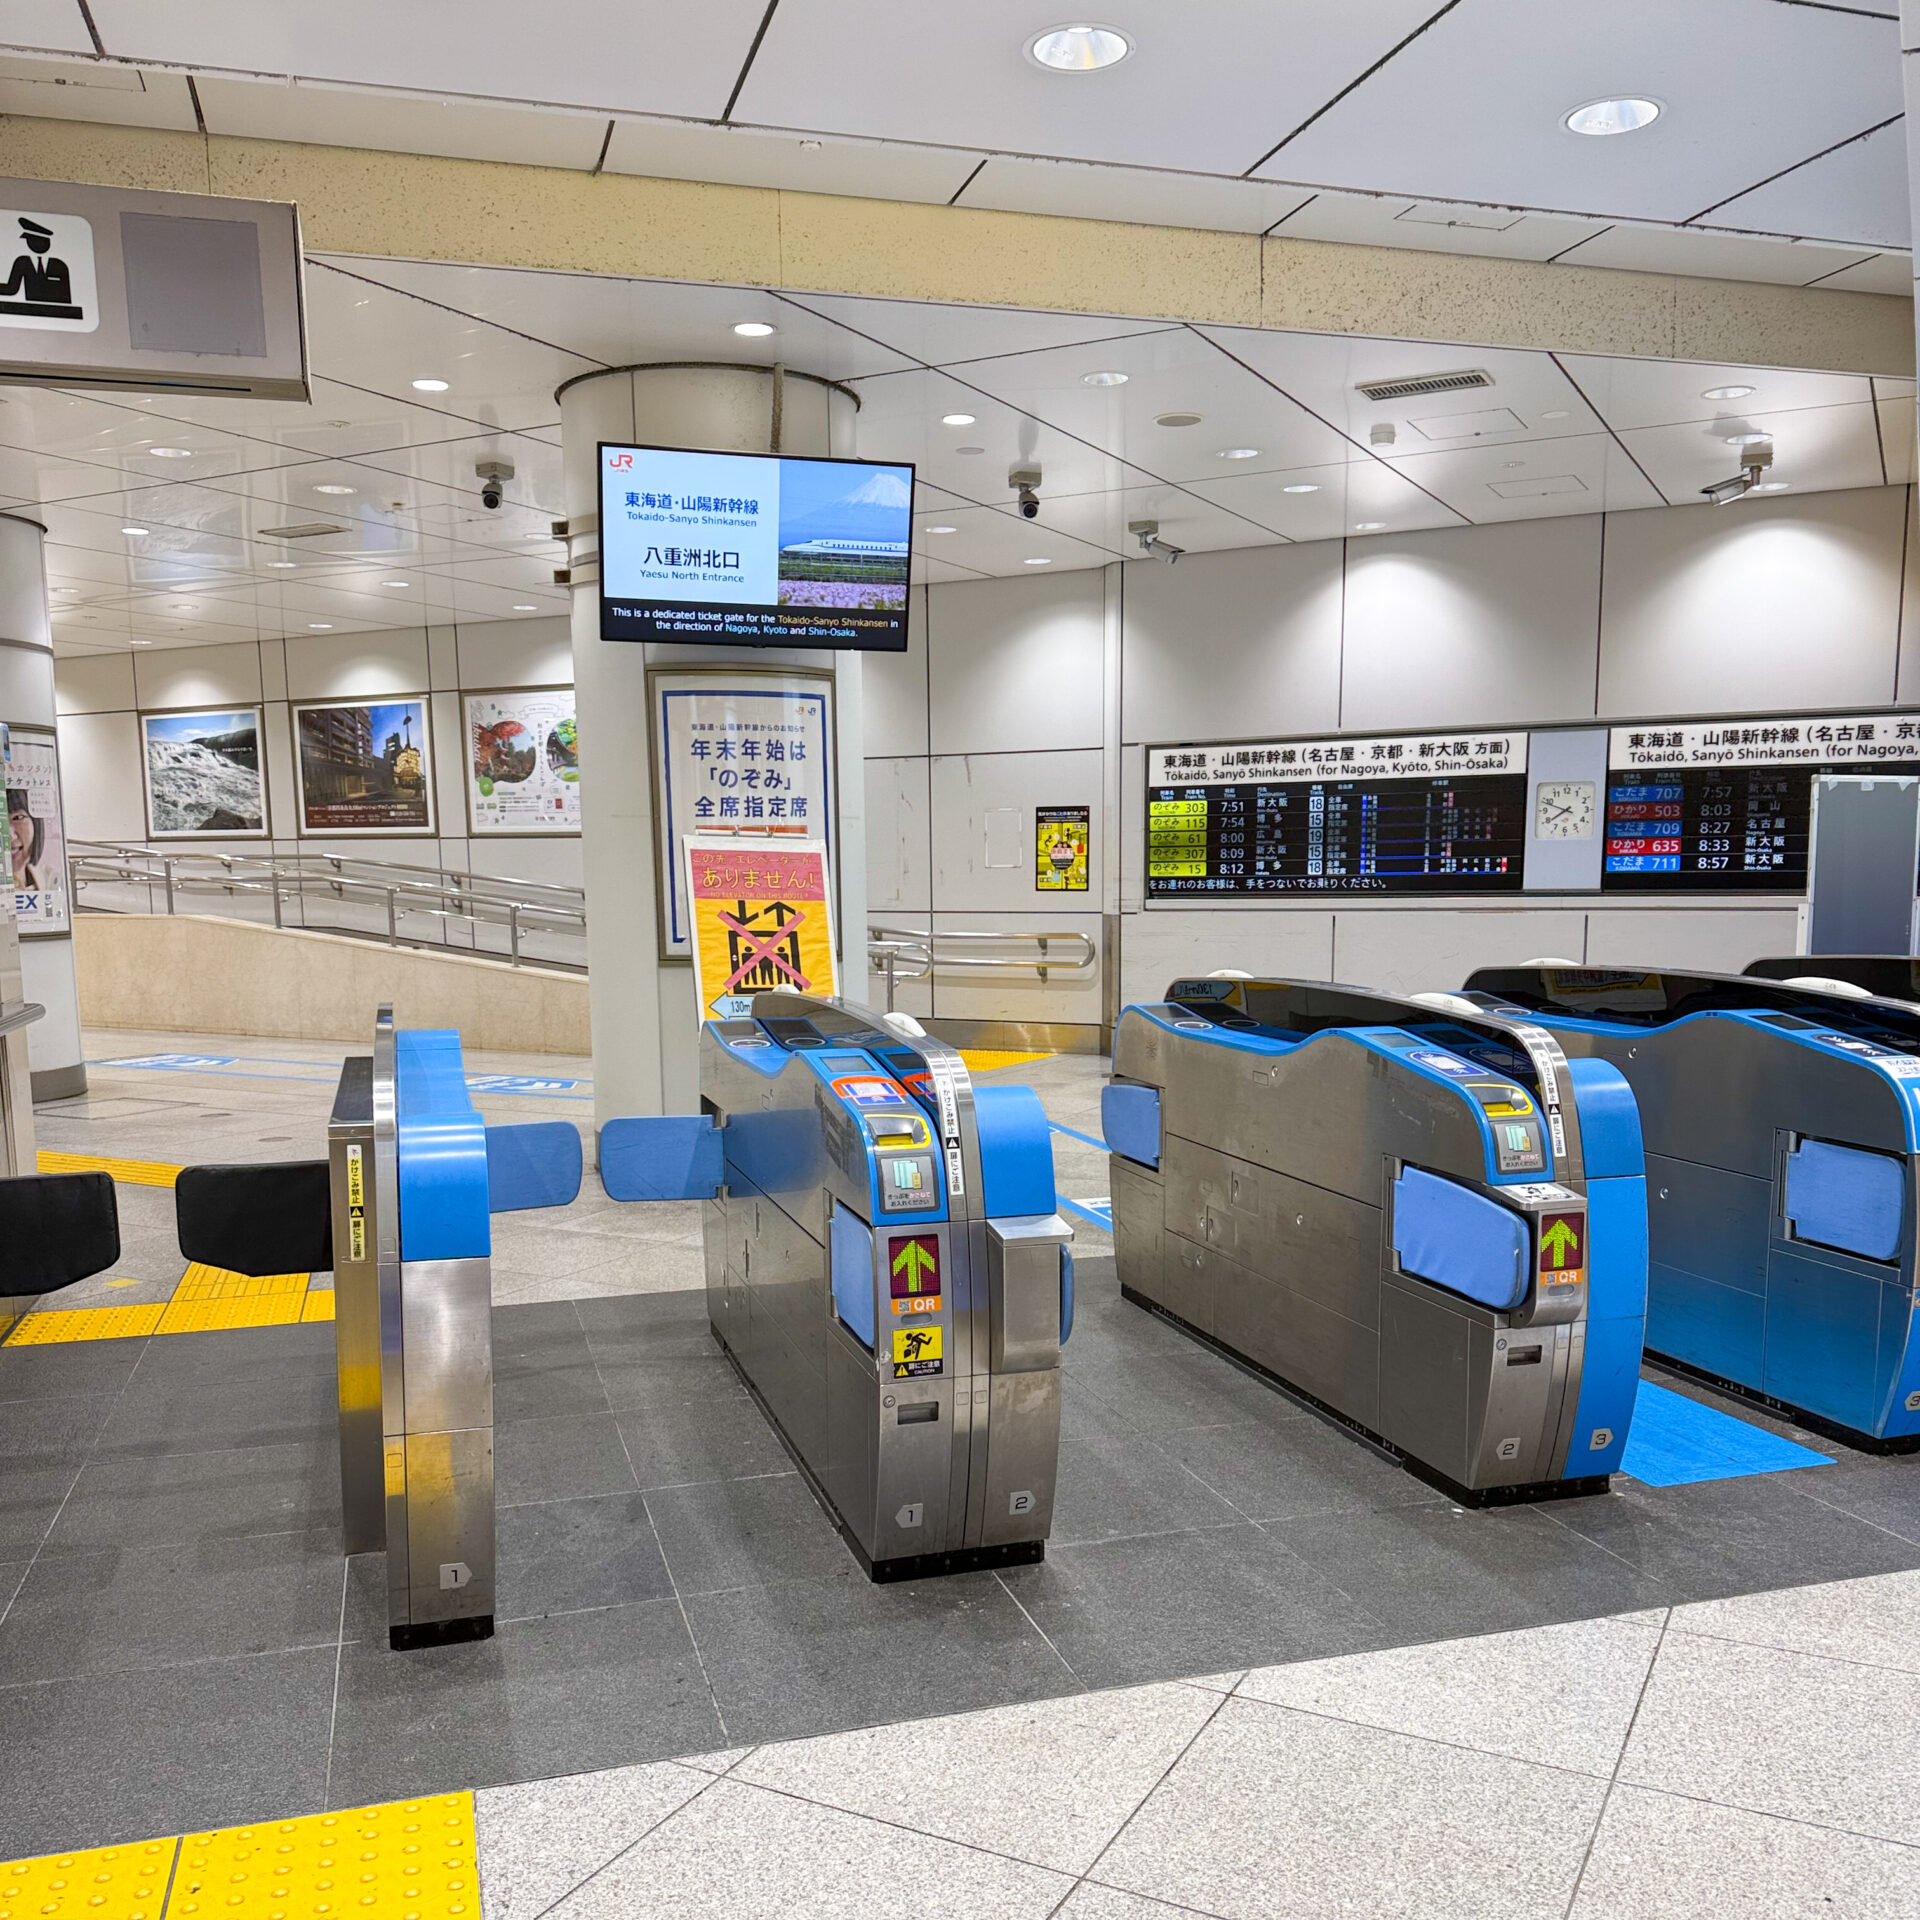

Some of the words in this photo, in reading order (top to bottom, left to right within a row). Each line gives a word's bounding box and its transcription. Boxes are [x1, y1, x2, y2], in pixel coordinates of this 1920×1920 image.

[609, 454, 633, 468] JR
[625, 491, 759, 515] 東海道・山陽新幹線
[627, 511, 699, 529] Tokaido-Sanyo
[701, 515, 757, 527] Shinkansen
[643, 547, 740, 569] 八重洲北口
[640, 569, 669, 579] Yaesu
[671, 571, 699, 581] North
[702, 573, 745, 583] Entrance
[612, 607, 632, 617] This
[633, 608, 642, 618] is
[643, 610, 650, 618] a
[652, 609, 696, 620] dedicated
[697, 611, 722, 621] ticket
[724, 613, 744, 623] gate
[746, 613, 759, 623] for
[761, 614, 776, 624] the
[778, 614, 840, 627] Tokaido-Sanyo
[841, 617, 889, 628] Shinkansen
[890, 619, 899, 628] in
[656, 620, 672, 630] the
[673, 620, 712, 632] direction
[714, 622, 724, 632] of
[725, 623, 761, 635] Nagoya,
[763, 625, 788, 635] Kyoto
[790, 626, 806, 635] and
[808, 627, 858, 637] Shin-Osaka.
[807, 707, 817, 716] JR
[1628, 727, 1799, 748] 東海道・山陽新幹線
[1807, 722, 1920, 743] (名古屋・京
[690, 738, 807, 761] 年末年始は
[1738, 746, 1819, 759] Shinkansen
[1826, 744, 1853, 757] (for
[1857, 744, 1919, 759] Nagoya,
[1163, 750, 1297, 769] 東海道・山陽新幹線
[1249, 767, 1312, 778] Shinkansen
[1317, 765, 1337, 777] (for
[1341, 763, 1390, 777] Nagoya,
[709, 767, 791, 791] 「のぞみ」
[1655, 787, 1681, 799] 707
[1702, 786, 1733, 799] 7:57
[694, 796, 808, 819] 全席指定席
[1154, 803, 1180, 811] のぞみ
[1185, 803, 1206, 814] 303
[1221, 801, 1244, 813] 7:51
[1311, 799, 1323, 811] 18
[1615, 804, 1647, 814] ひかり
[1655, 805, 1681, 817] 503
[1701, 804, 1732, 816] 8:03
[1153, 818, 1180, 826] のぞみ
[1186, 818, 1206, 829] 115
[1221, 817, 1245, 828] 7:54
[1310, 814, 1322, 826] 15
[1654, 822, 1680, 835] 709
[1700, 821, 1731, 834] 8:27
[1153, 833, 1180, 841] のぞみ
[1188, 834, 1201, 844] 61
[1221, 832, 1245, 844] 8:00
[1310, 830, 1322, 842] 19
[1612, 839, 1645, 849] ひかり
[1652, 840, 1679, 852] 635
[1699, 839, 1730, 852] 8:33
[1745, 836, 1785, 847] 新大阪
[1153, 848, 1179, 857] のぞみ
[1184, 848, 1205, 859] 307
[1221, 848, 1245, 859] 8:09
[1309, 846, 1321, 858] 15
[1153, 863, 1179, 872] のぞみ
[1188, 864, 1202, 874] 15
[1220, 863, 1244, 875] 8:12
[1309, 861, 1321, 873] 18
[1612, 856, 1645, 866] こだま
[1652, 857, 1677, 870] 711
[1697, 857, 1729, 869] 8:57
[1744, 853, 1784, 865] 新大阪
[1559, 1271, 1578, 1283] QR
[914, 1297, 936, 1312] QR
[1594, 1433, 1607, 1446] 3
[1502, 1442, 1516, 1456] 2
[1015, 1496, 1028, 1510] 2
[907, 1510, 914, 1523] 1
